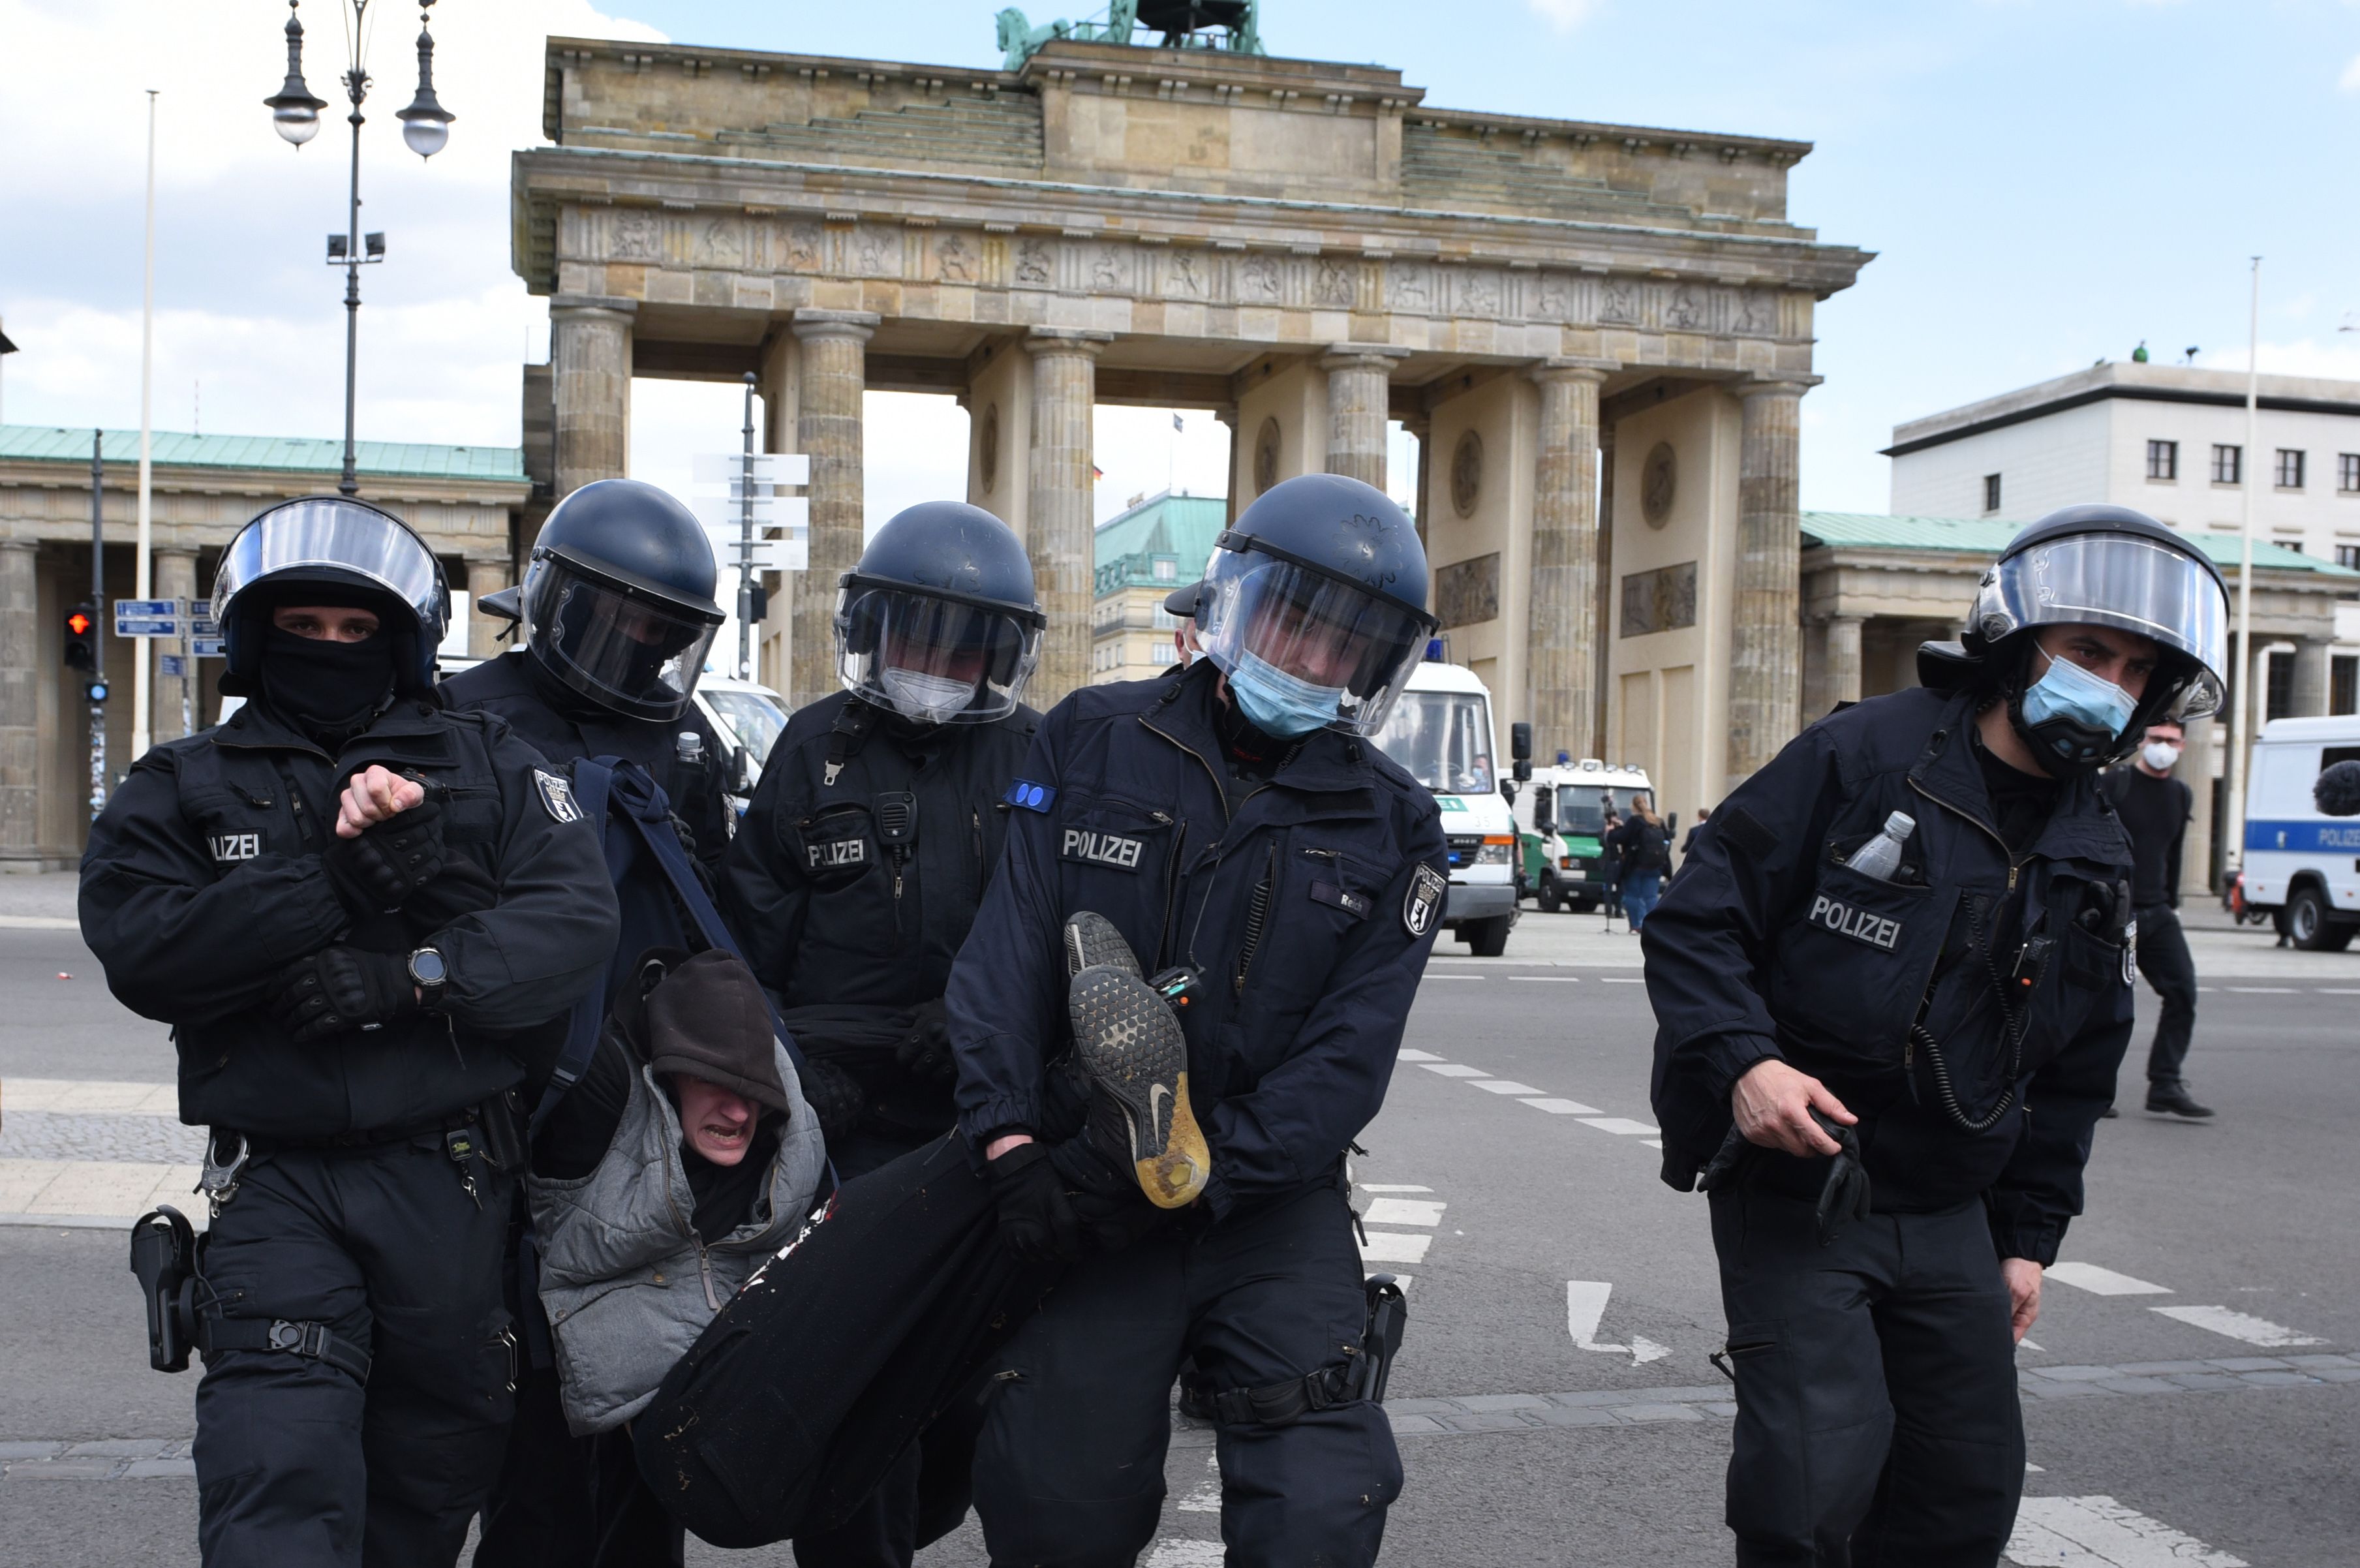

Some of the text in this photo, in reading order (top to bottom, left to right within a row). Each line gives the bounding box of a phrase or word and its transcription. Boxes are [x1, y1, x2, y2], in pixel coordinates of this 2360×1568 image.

[1063, 829, 1142, 868] POLIZEI
[1341, 894, 1363, 912] Reich
[1809, 895, 1901, 949] POLIZEI
